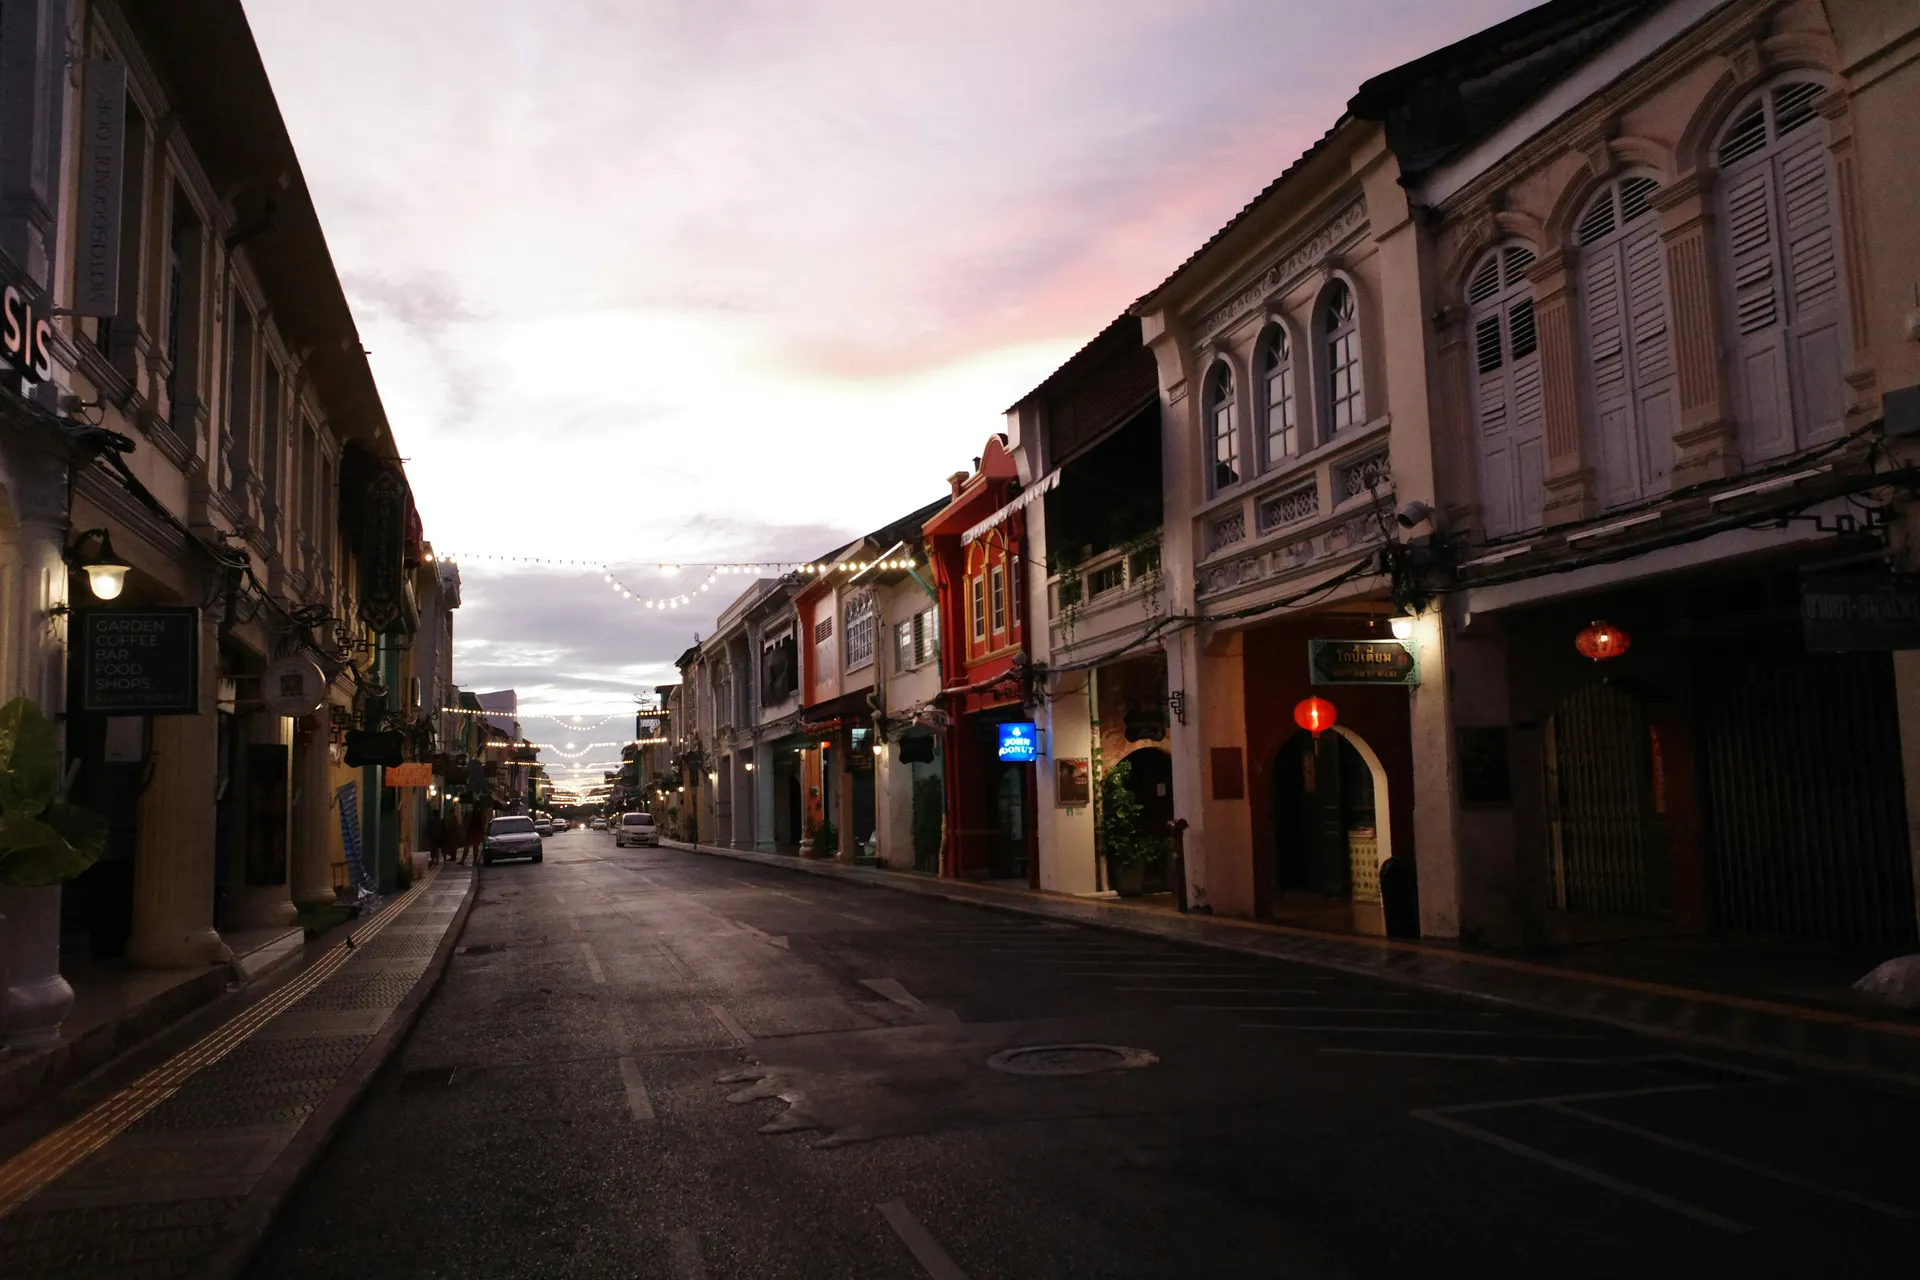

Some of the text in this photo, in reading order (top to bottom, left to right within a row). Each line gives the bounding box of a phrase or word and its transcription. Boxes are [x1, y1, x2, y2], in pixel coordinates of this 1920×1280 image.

[96, 620, 165, 632] GARDEN
[95, 634, 159, 647] COFFEE
[95, 649, 129, 660] BAR
[95, 663, 143, 675] FOOD
[95, 677, 152, 690] SHOPS
